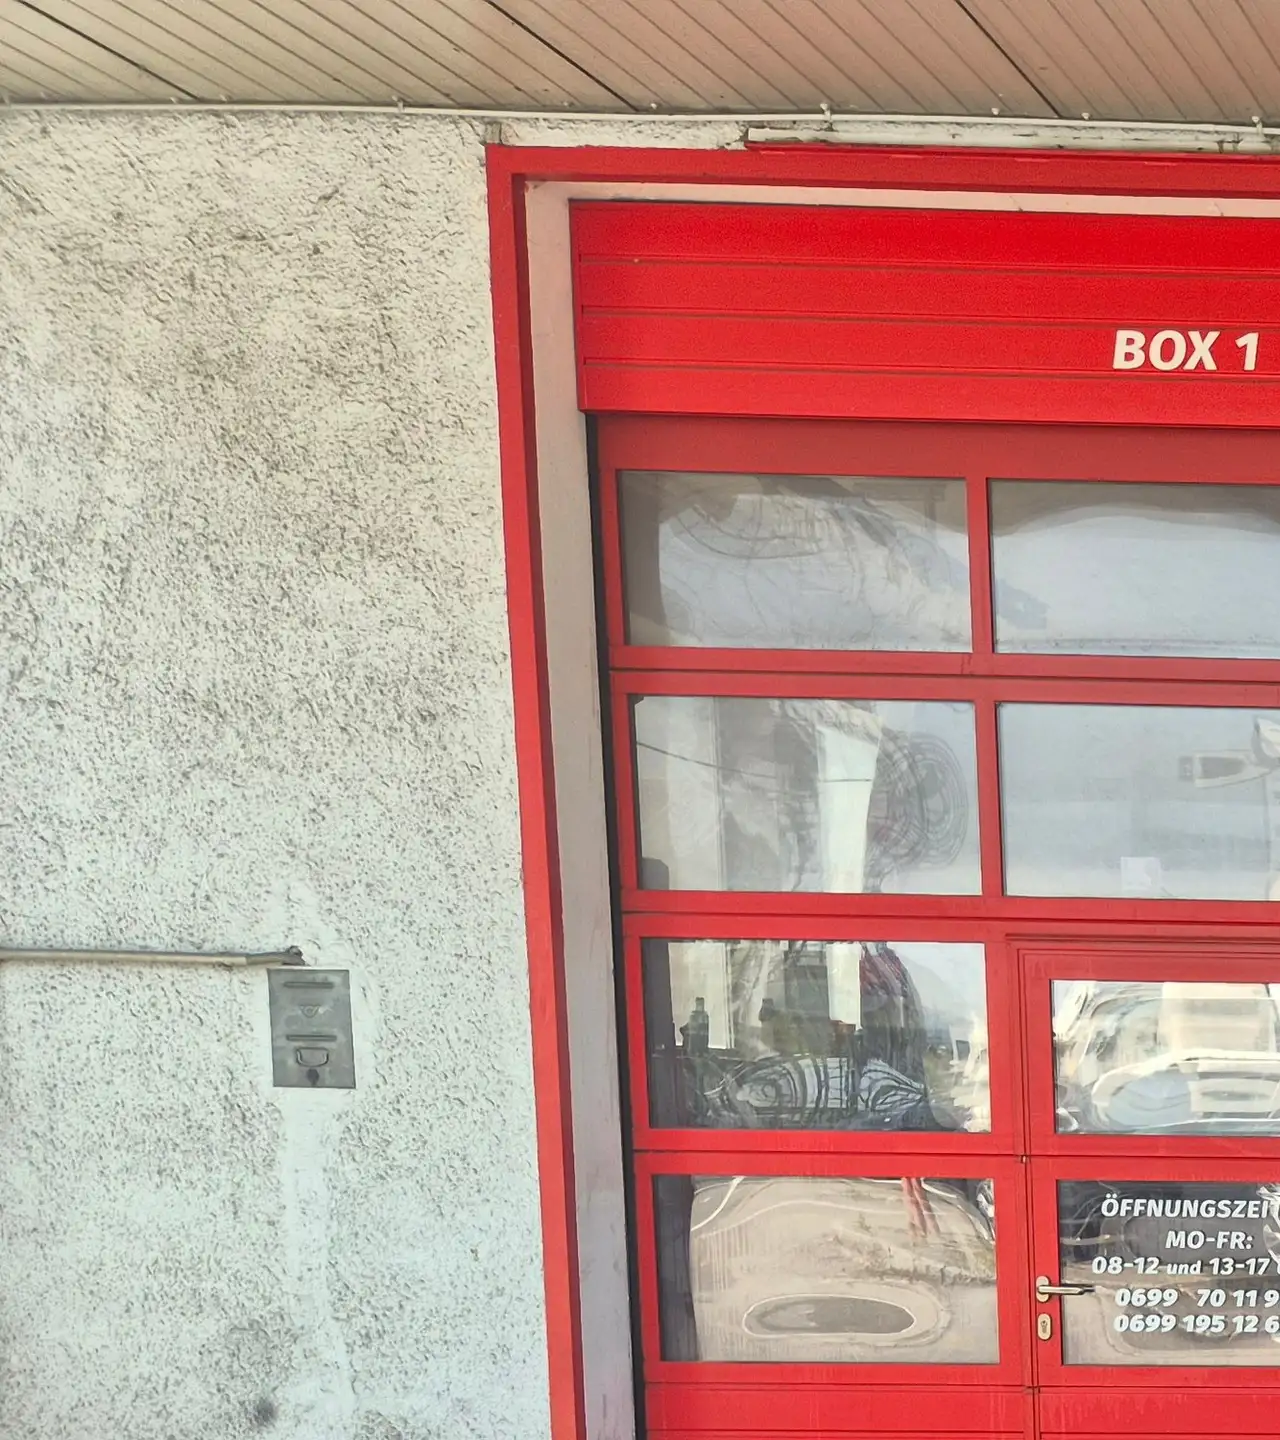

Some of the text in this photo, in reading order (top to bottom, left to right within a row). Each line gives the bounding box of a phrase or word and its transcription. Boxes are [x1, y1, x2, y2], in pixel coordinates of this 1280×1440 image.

[1112, 329, 1260, 371] BOX 1
[1165, 1231, 1254, 1250] MO-FR:
[1091, 1256, 1160, 1275] 08-12
[1166, 1260, 1201, 1275] und
[1209, 1257, 1270, 1275] 13-17
[1115, 1288, 1178, 1308] 0699
[1197, 1289, 1226, 1308] 70
[1232, 1290, 1258, 1308] 11
[1113, 1314, 1177, 1333] 0699
[1182, 1314, 1226, 1334] 195
[1232, 1315, 1259, 1333] 12
